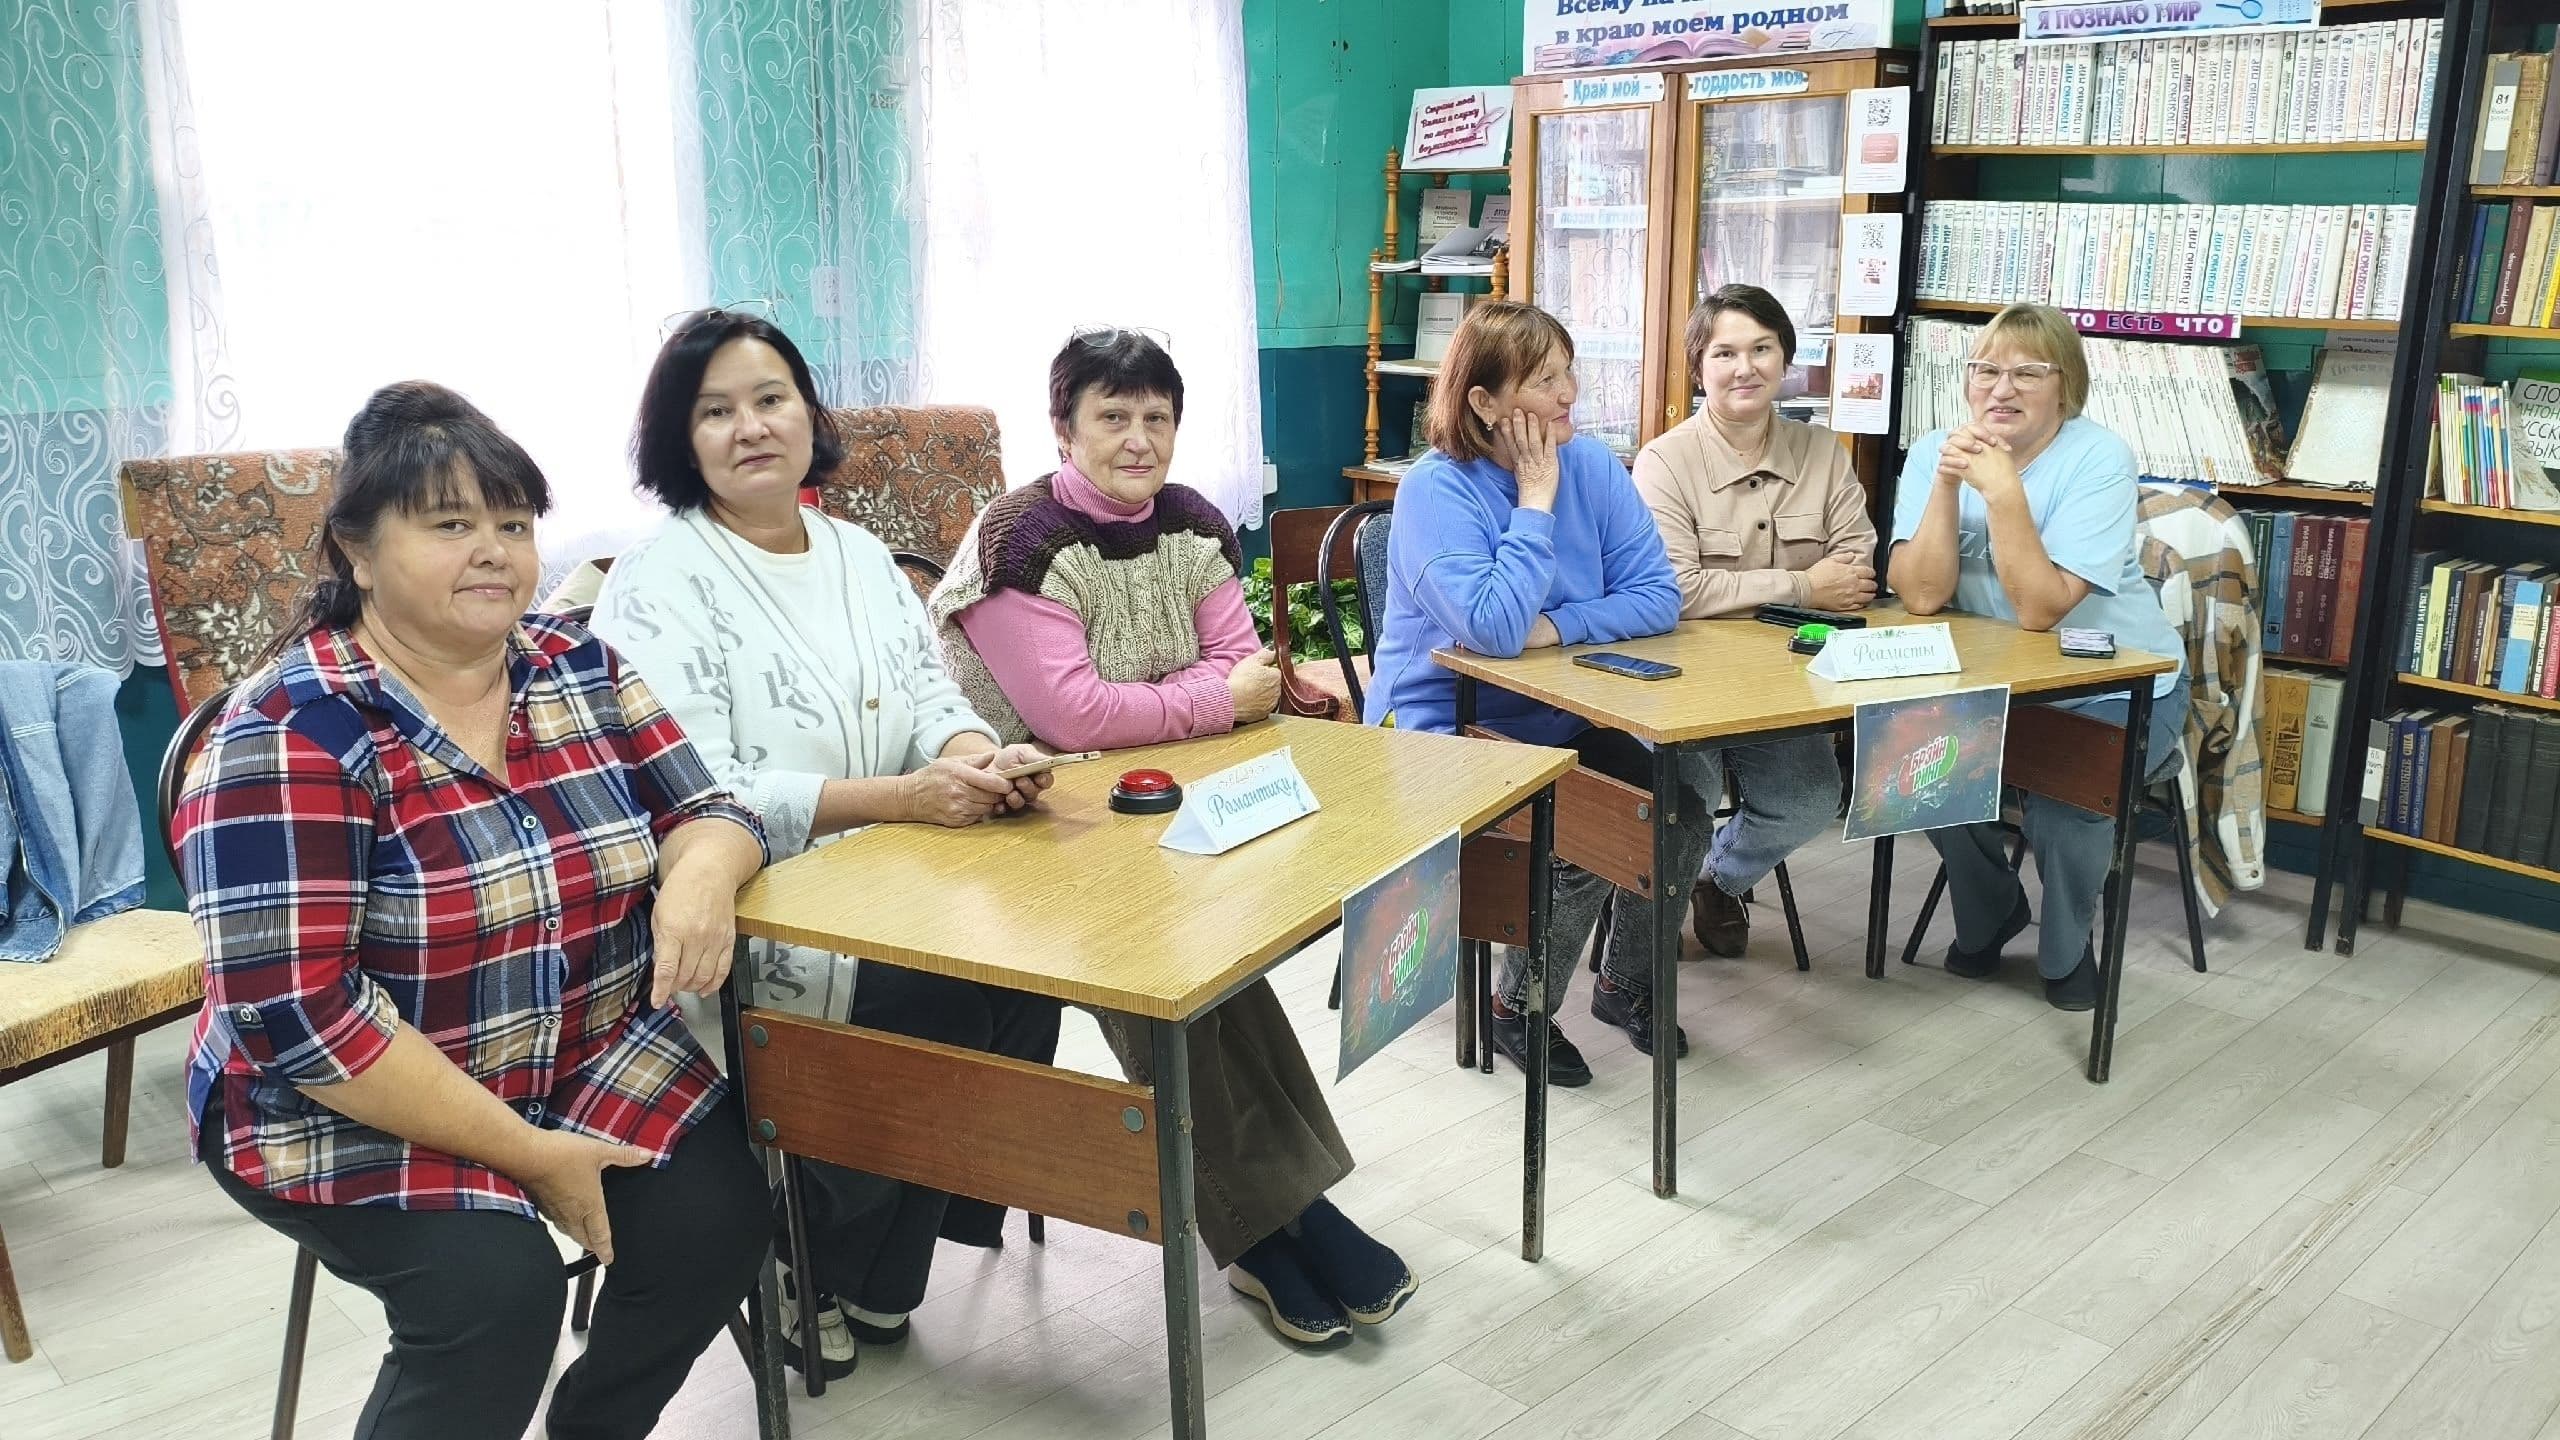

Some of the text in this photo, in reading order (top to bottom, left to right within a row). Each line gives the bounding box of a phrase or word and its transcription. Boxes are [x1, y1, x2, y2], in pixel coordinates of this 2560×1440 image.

[1555, 3, 1850, 49] в краю моем родном
[2037, 1, 2202, 30] Я ПОЗНАЮ МИР
[1573, 78, 1608, 104] Край
[1611, 75, 1641, 97] мой
[1693, 72, 1767, 98] гордость
[2496, 94, 2510, 105] 81
[2066, 312, 2225, 334] ТО ЕСТЬ ЧТО
[1853, 642, 1936, 665] Реалисты
[1908, 735, 1948, 776] БРЭЙН
[1912, 761, 1943, 795] РИНГ
[1207, 776, 1292, 828] Романтики
